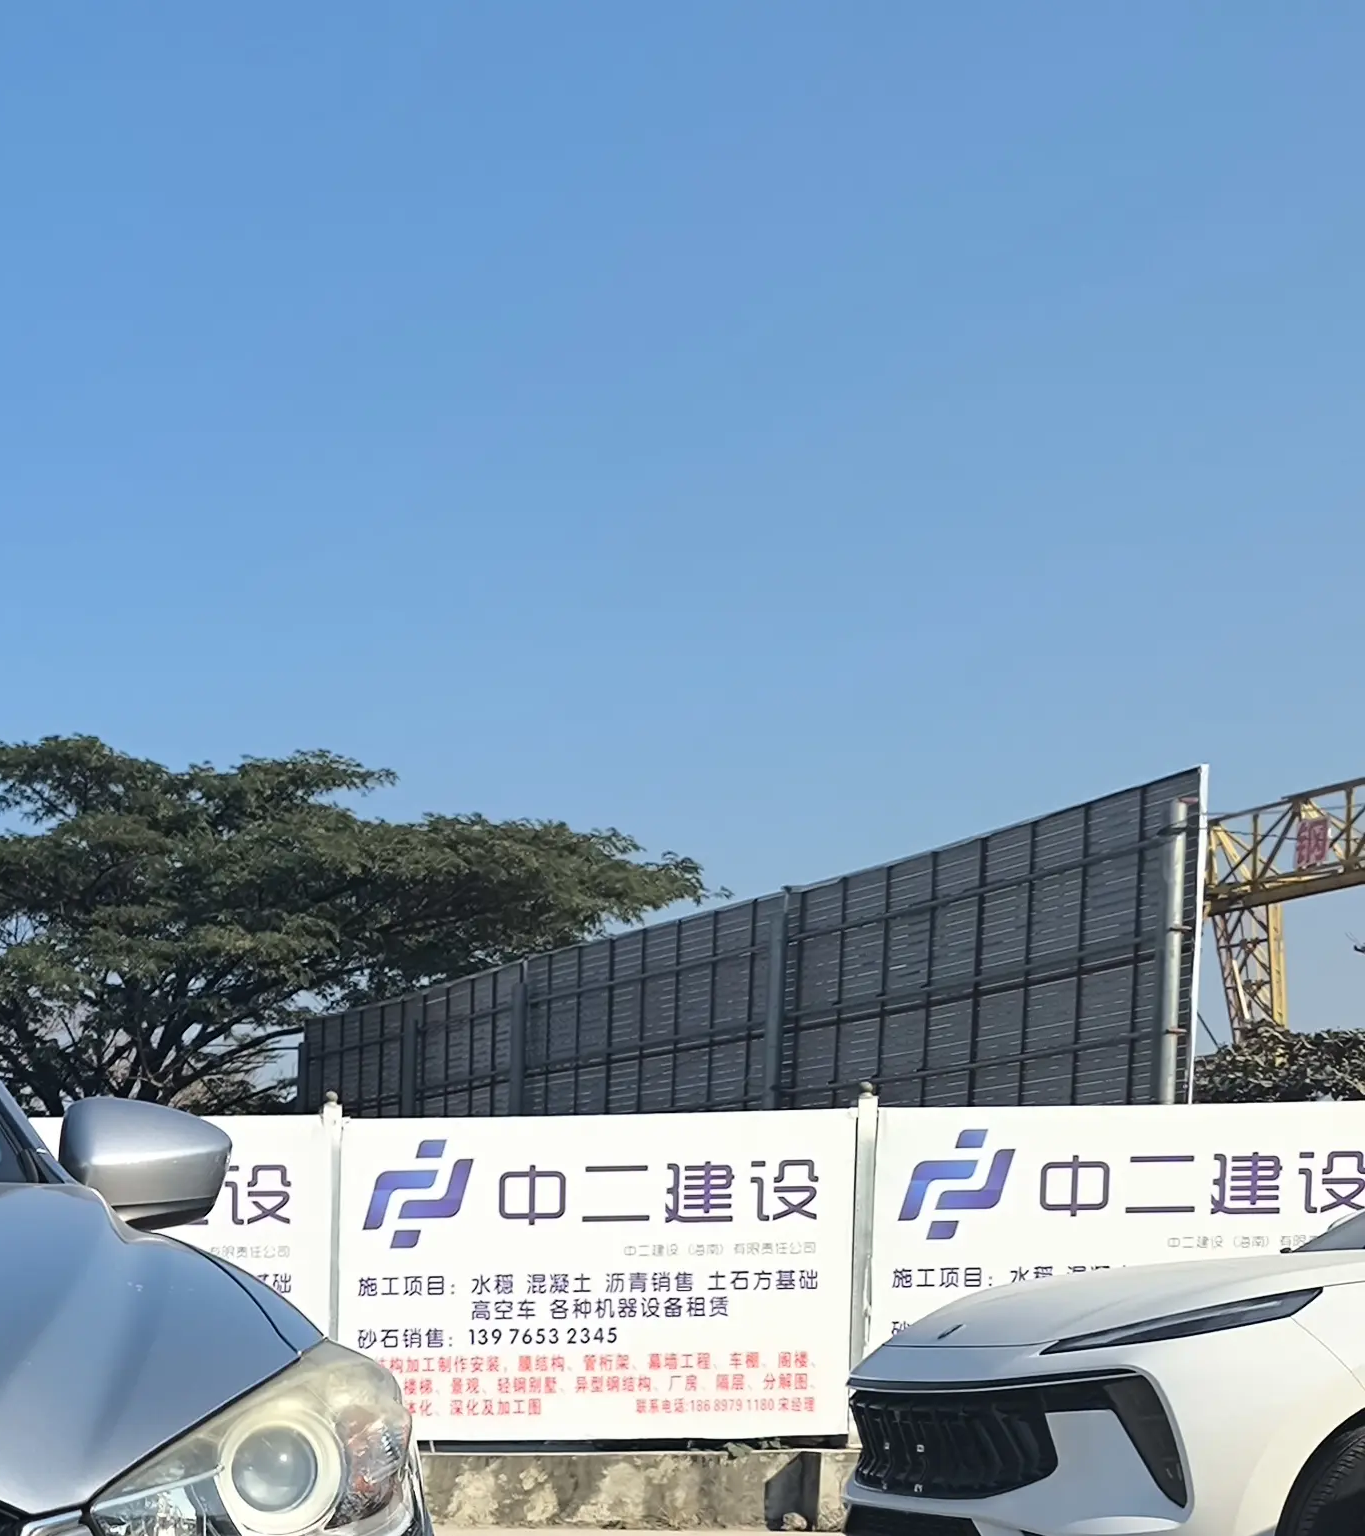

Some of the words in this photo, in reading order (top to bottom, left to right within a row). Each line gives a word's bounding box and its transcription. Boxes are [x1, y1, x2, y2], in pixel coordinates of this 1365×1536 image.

[498, 1159, 819, 1225] 中二建设
[1039, 1150, 1365, 1216] 中二建设
[526, 1273, 592, 1294] 混凝土
[605, 1271, 693, 1293] 沥青销售
[707, 1270, 818, 1291] 土石方基础
[471, 1298, 537, 1320] 高空车
[549, 1296, 729, 1319] 各种机器设备租赁
[469, 1328, 502, 1345] 139
[509, 1327, 560, 1345] 7653
[567, 1327, 618, 1345] 2345
